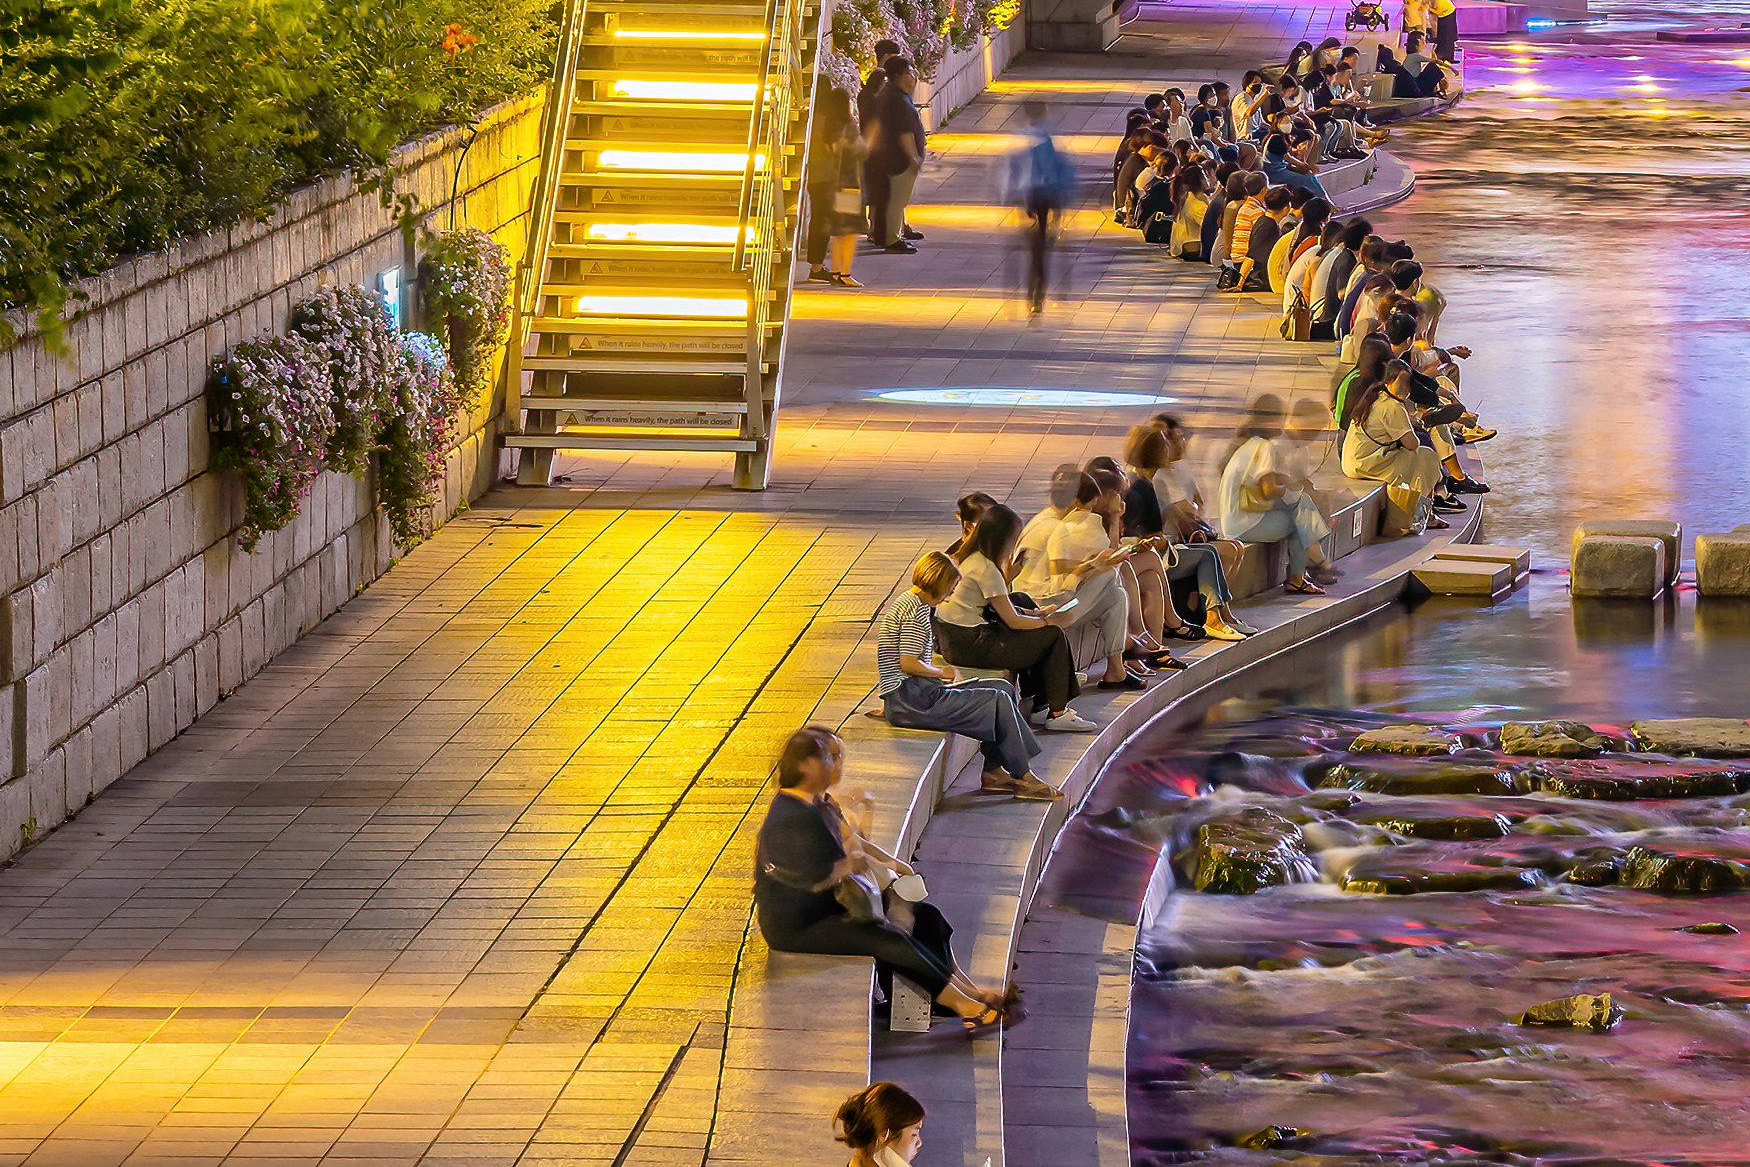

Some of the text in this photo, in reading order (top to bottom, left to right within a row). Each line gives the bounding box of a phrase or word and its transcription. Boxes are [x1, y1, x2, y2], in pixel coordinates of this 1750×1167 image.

[681, 342, 697, 350] path
[630, 417, 655, 425] heavily,
[670, 417, 686, 426] path
